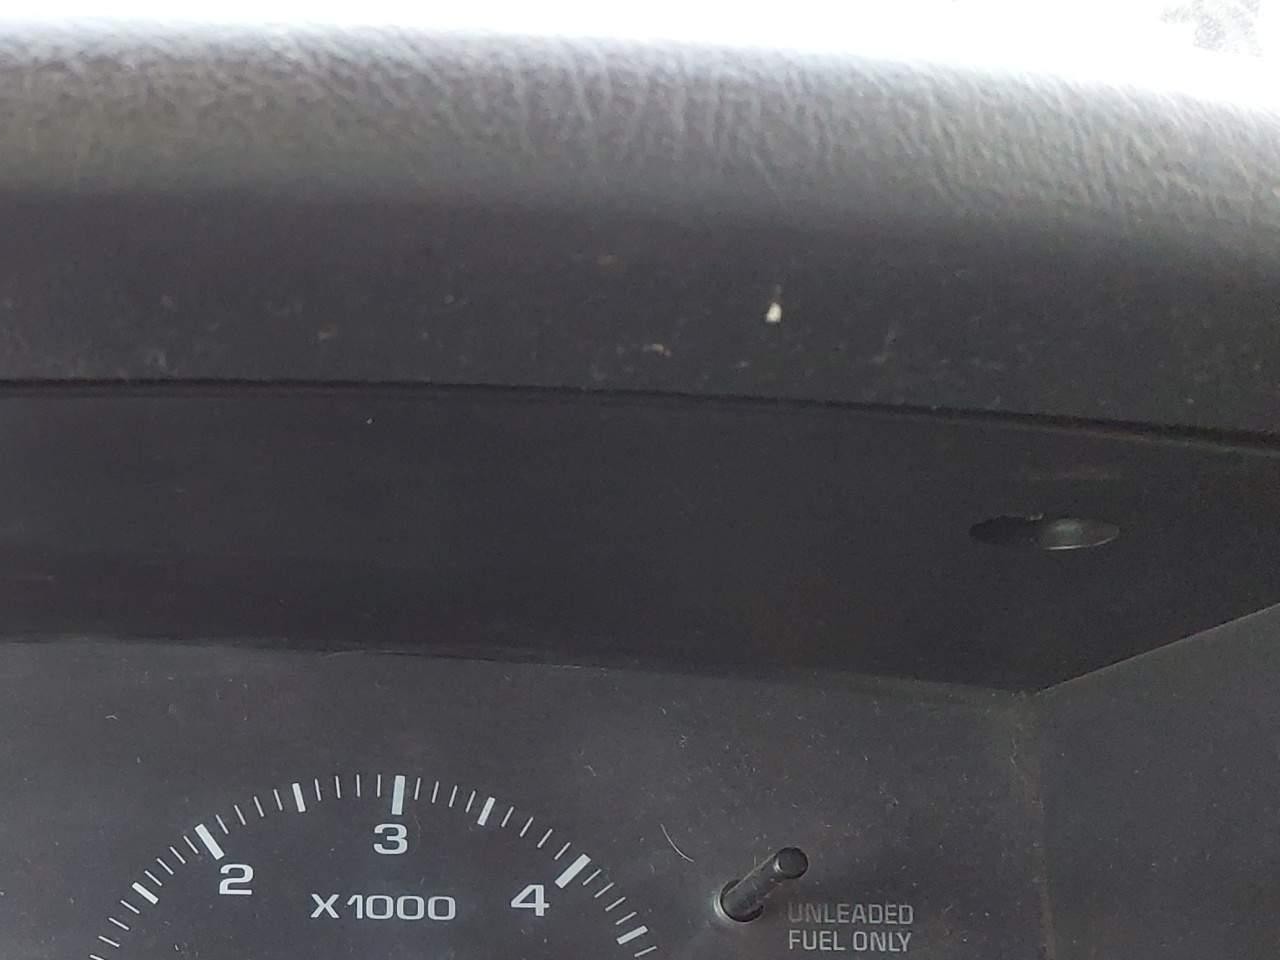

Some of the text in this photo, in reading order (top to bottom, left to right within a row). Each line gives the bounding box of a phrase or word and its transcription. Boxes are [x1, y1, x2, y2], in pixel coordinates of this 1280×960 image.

[373, 823, 408, 854] 3
[219, 863, 254, 895] 2
[510, 884, 550, 916] 4
[788, 902, 914, 925] UNLEADED
[788, 930, 912, 952] FUEL ONLY
